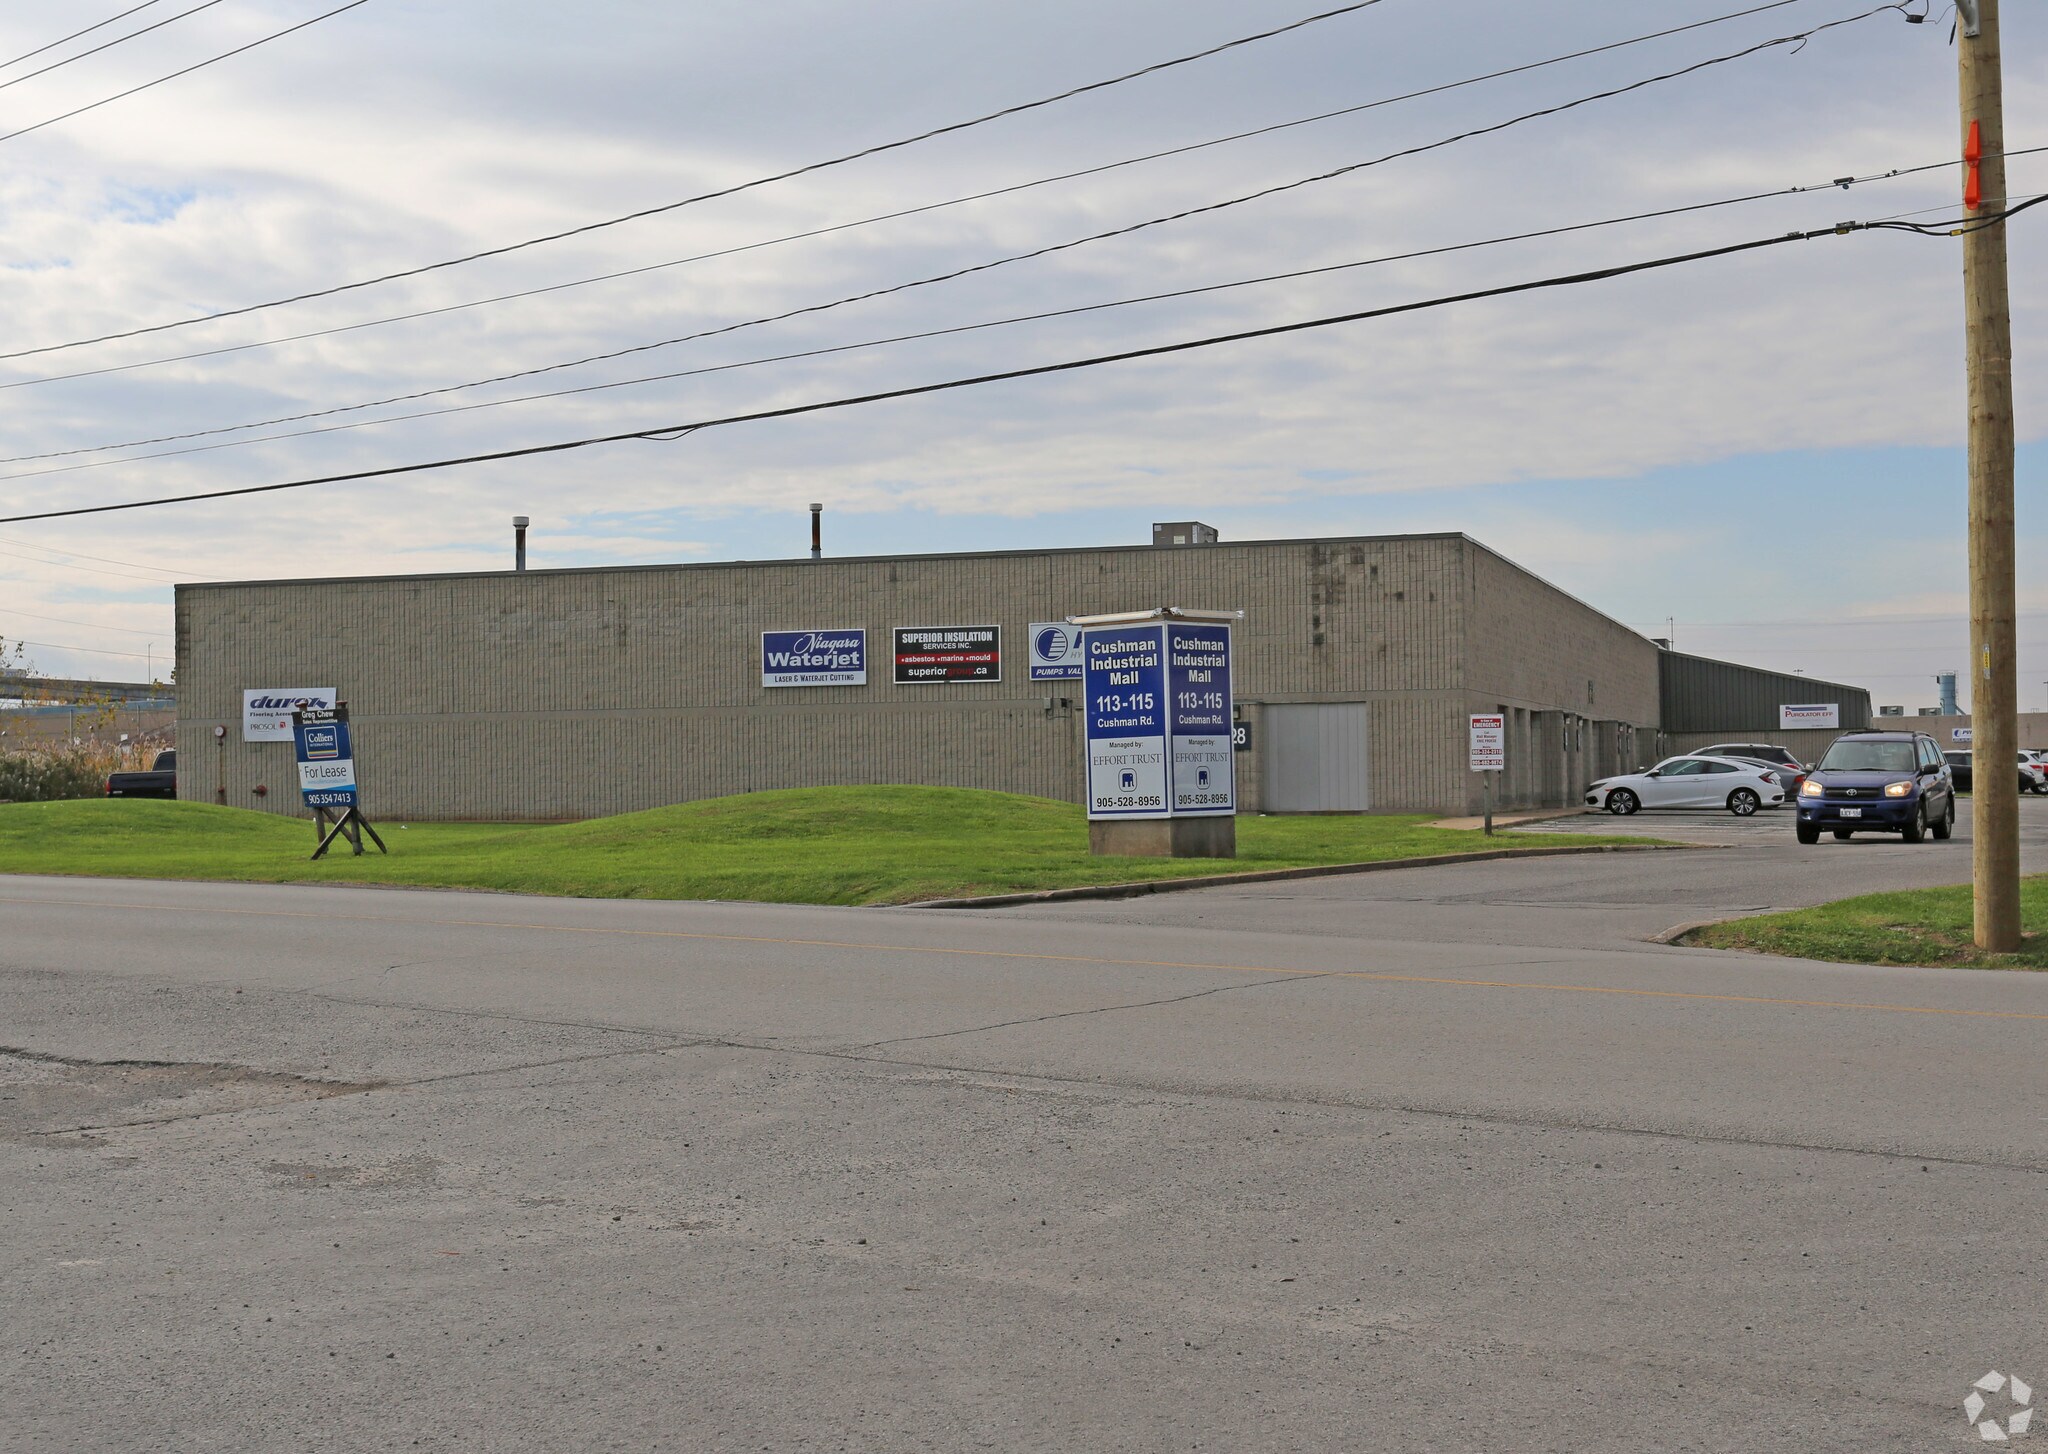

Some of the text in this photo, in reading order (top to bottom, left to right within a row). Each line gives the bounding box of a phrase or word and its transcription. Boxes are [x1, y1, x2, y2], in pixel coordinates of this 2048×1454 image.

[902, 631, 993, 643] SUPERIOR INSULATION
[793, 633, 860, 656] Niagara
[1091, 639, 1156, 654] Cushman
[1173, 637, 1224, 651] Cushman
[767, 650, 860, 669] Waterjet
[940, 654, 964, 662] marine
[969, 653, 991, 661] mould
[1090, 653, 1157, 670] Industrial
[1173, 653, 1225, 667] Industrial
[1036, 668, 1064, 676] PUMPS
[1110, 670, 1139, 685] Mall
[1188, 669, 1211, 683] Mall
[774, 675, 793, 683] LASER
[800, 674, 828, 682] WATERJET
[1096, 693, 1154, 712] 113-115
[1178, 692, 1223, 709] 113-115
[301, 710, 334, 719] Greg Chew
[1178, 715, 1224, 725] Cushman Rd.
[1097, 716, 1155, 728] Cushman Rd.
[308, 733, 334, 743] Colliers
[1188, 738, 1208, 746] Managed
[1109, 741, 1144, 749] Managed by:
[1093, 753, 1162, 766] EFFORT TRUST
[1175, 752, 1229, 763] EFFORT TRUST
[304, 765, 347, 779] For Lease
[308, 793, 351, 804] 905 354 7413
[1096, 795, 1161, 808] 905-528-8956
[1178, 793, 1229, 805] 905-528-8956
